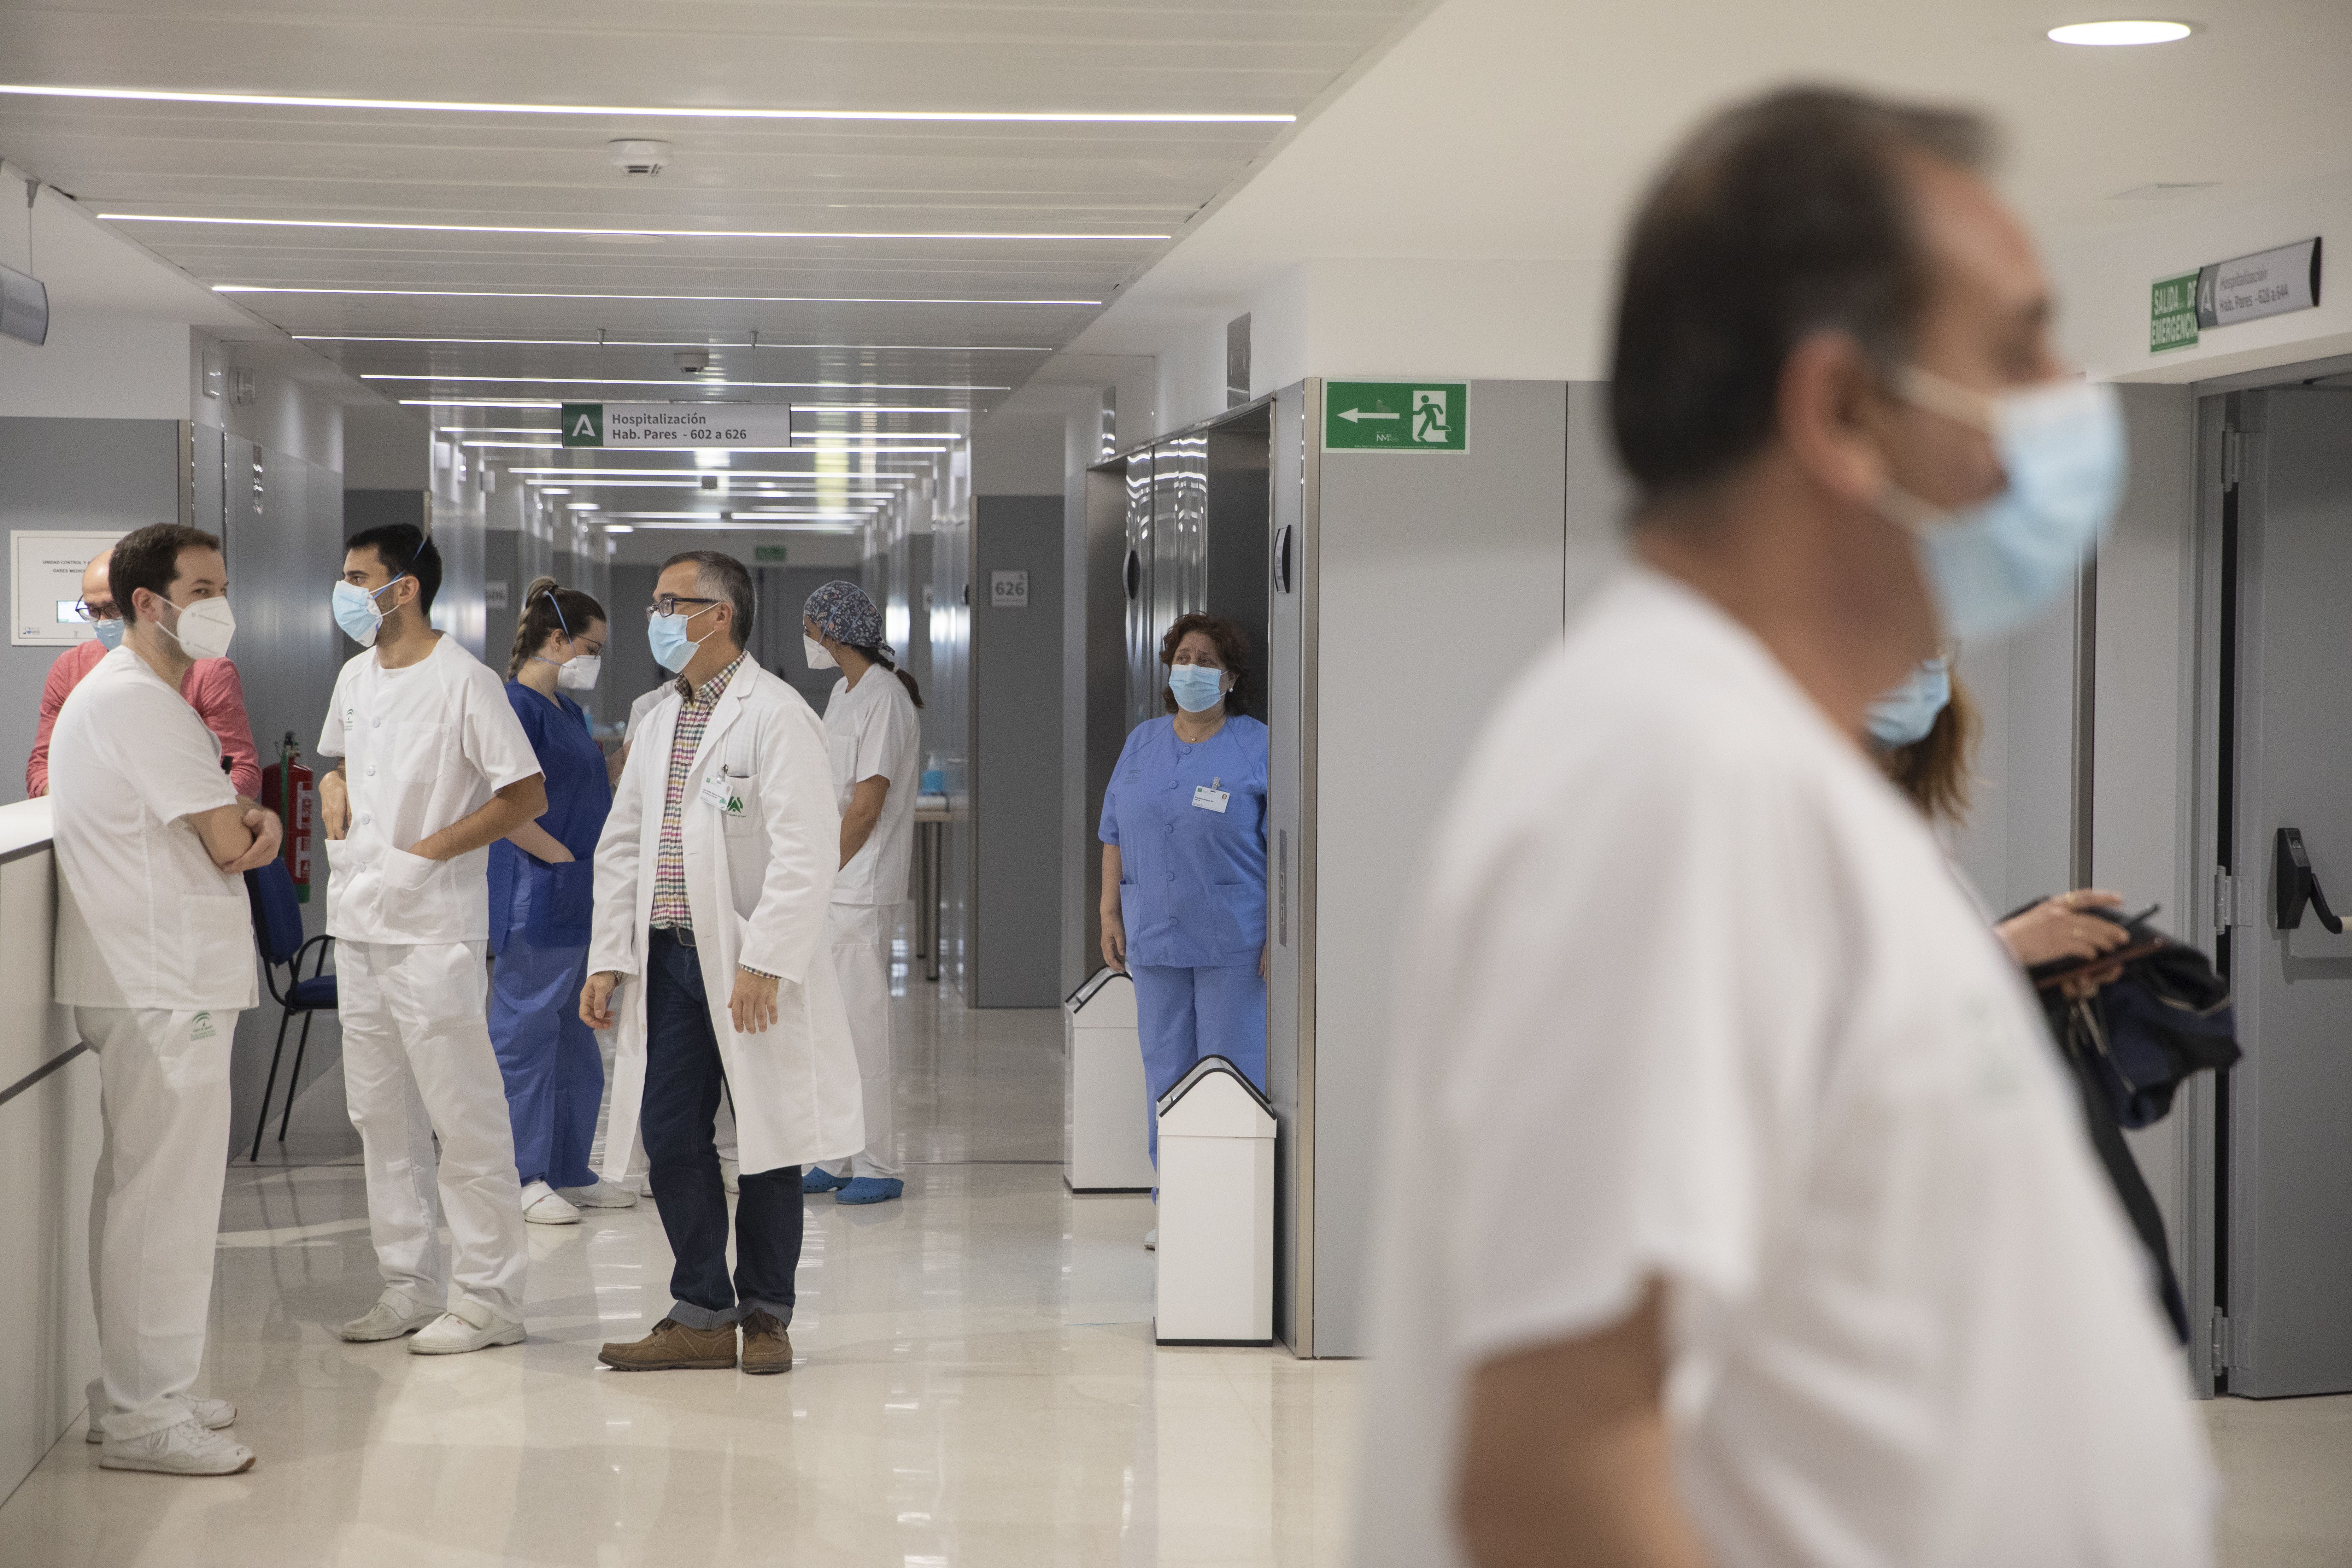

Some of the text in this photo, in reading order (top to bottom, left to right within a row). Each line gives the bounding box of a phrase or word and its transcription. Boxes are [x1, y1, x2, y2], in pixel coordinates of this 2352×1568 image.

[2154, 285, 2178, 315] SALIDA
[612, 412, 706, 427] Hospitalización
[613, 429, 640, 439] Hab.
[644, 429, 677, 439] Pares
[691, 429, 711, 439] 602
[715, 431, 722, 439] a
[725, 429, 746, 439] 626
[995, 582, 1024, 595] 626
